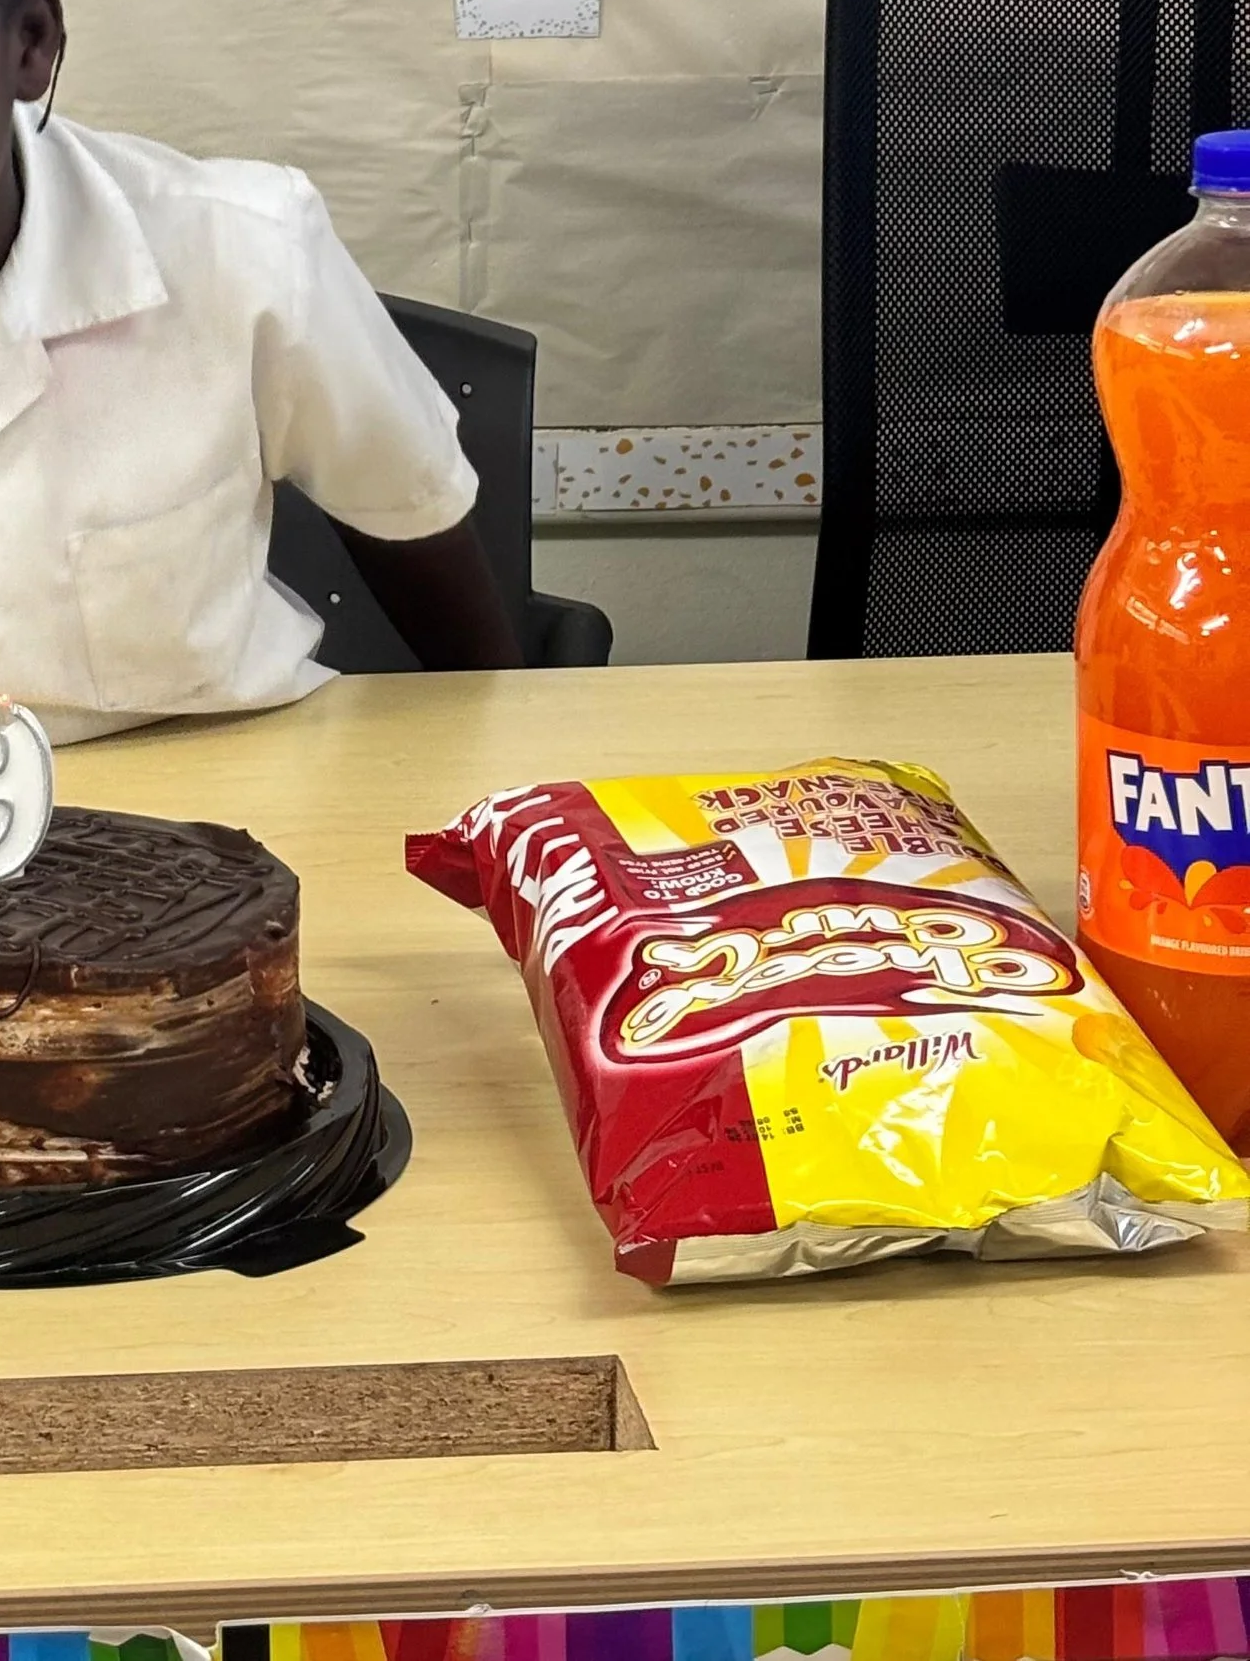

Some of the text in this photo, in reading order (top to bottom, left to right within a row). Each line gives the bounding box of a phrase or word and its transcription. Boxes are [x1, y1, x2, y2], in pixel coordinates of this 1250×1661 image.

[692, 774, 853, 810] SNACK
[643, 905, 1007, 976] Curls
[623, 942, 1072, 1044] Cheese
[823, 1032, 976, 1090] Willards
